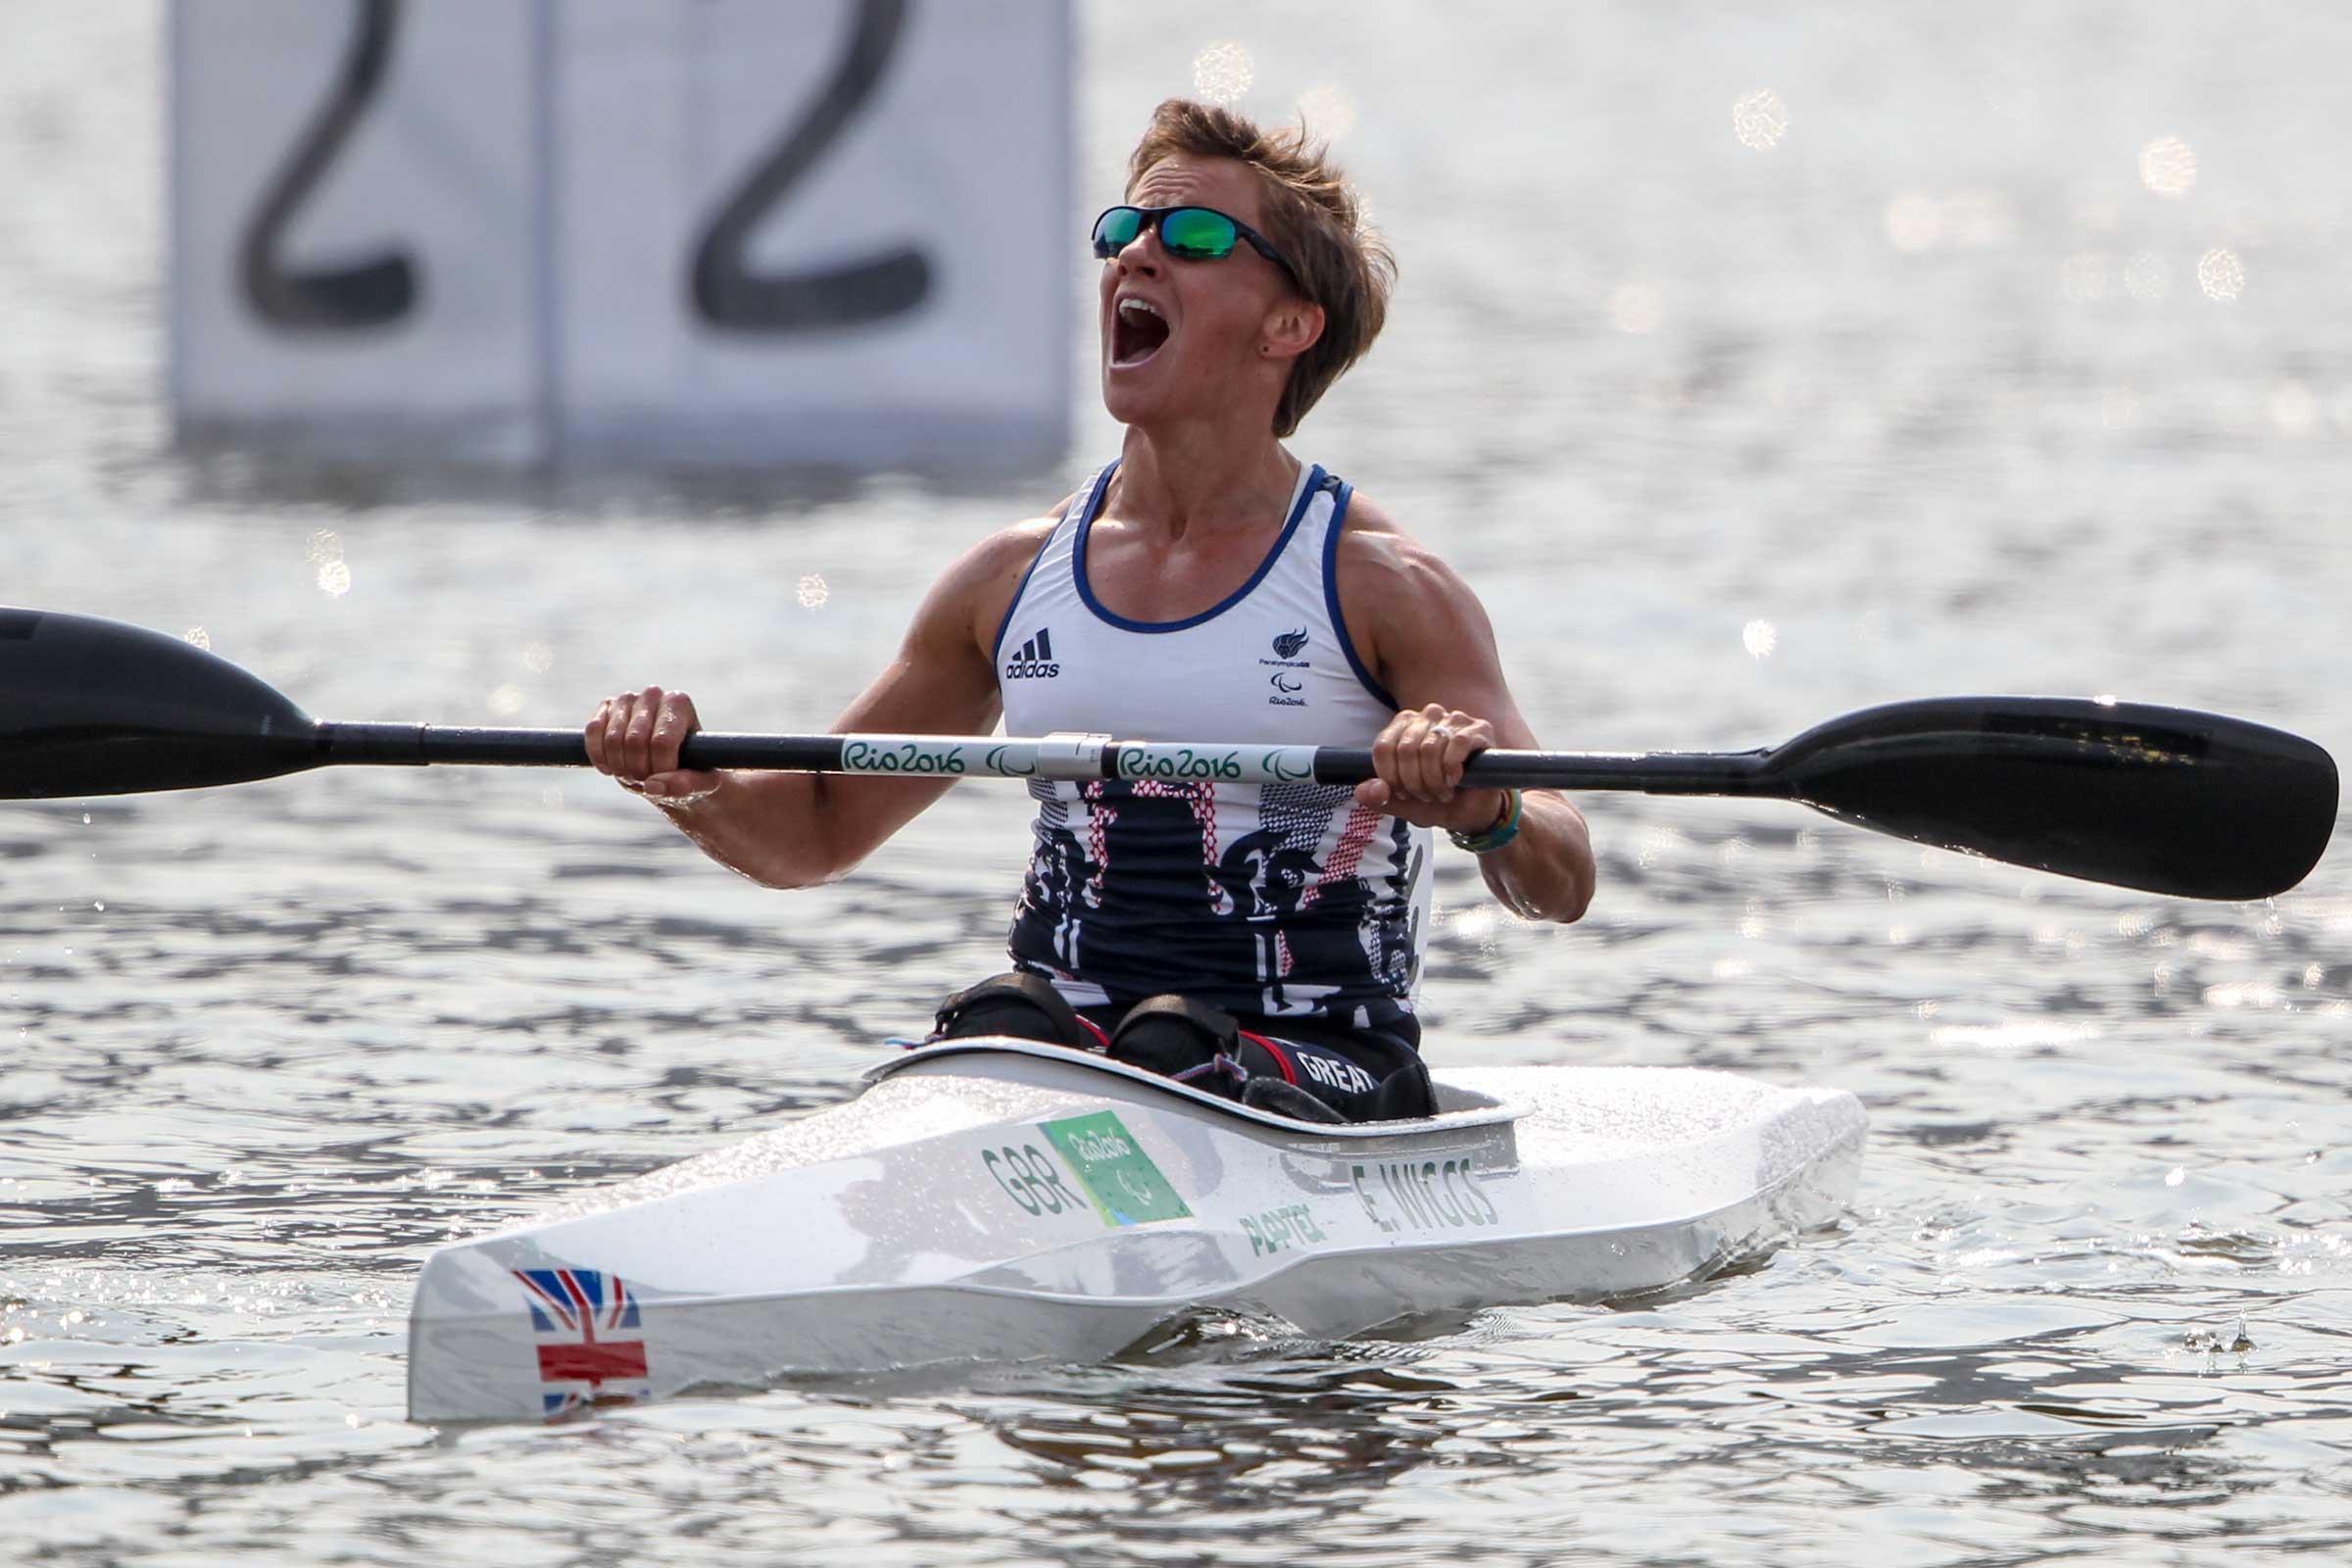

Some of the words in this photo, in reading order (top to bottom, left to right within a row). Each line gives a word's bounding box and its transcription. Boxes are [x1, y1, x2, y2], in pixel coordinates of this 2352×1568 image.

[1005, 660, 1060, 679] adidas
[1269, 696, 1305, 707] Rio2016
[843, 741, 965, 774] Rio2016
[1119, 748, 1242, 779] Rio2016
[1296, 1051, 1374, 1095] GREAT
[981, 1144, 1089, 1217] GBR
